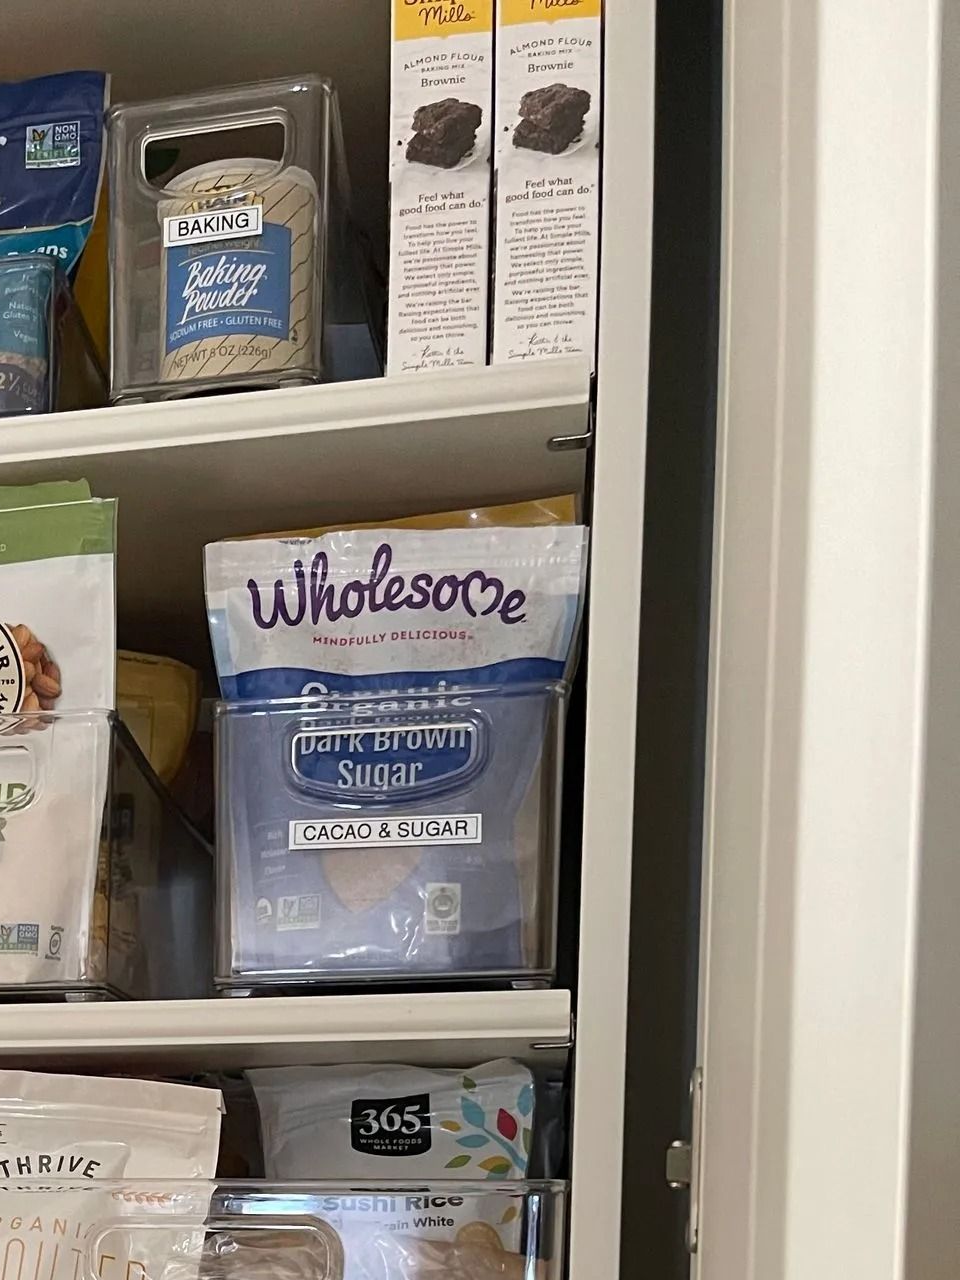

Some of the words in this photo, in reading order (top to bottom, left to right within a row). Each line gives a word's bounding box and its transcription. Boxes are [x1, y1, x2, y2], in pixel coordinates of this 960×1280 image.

[510, 39, 554, 55] ALMOND
[558, 38, 592, 47] FLOUR
[404, 54, 447, 71] ALMOND
[451, 53, 484, 62] FLOUR
[528, 61, 573, 73] Brownie
[421, 75, 466, 87] Brownie
[54, 132, 76, 141] GMO
[55, 124, 76, 133] NON
[525, 179, 545, 189] Feel
[548, 177, 572, 185] what
[419, 193, 437, 202] Feel
[441, 191, 464, 200] what
[505, 192, 529, 203] good
[532, 189, 553, 199] food
[399, 206, 422, 217] good
[425, 202, 446, 212] food
[178, 212, 249, 237] BAKING
[182, 255, 266, 297] Baking
[176, 282, 257, 325] Powder
[198, 317, 219, 329] FREE
[225, 315, 261, 326] GLUTEN
[263, 317, 283, 329] FREE
[247, 543, 526, 629] Wholesome
[313, 632, 386, 647] MINDFULLY
[391, 630, 466, 642] DELICIOUS
[301, 728, 364, 754] Dark
[373, 727, 467, 752] Brown
[338, 759, 423, 790] Sugar
[303, 823, 372, 841] CACAO
[379, 822, 391, 839] &
[397, 819, 469, 838] SUGAR
[359, 1104, 421, 1136] 365
[414, 1216, 455, 1228] White
